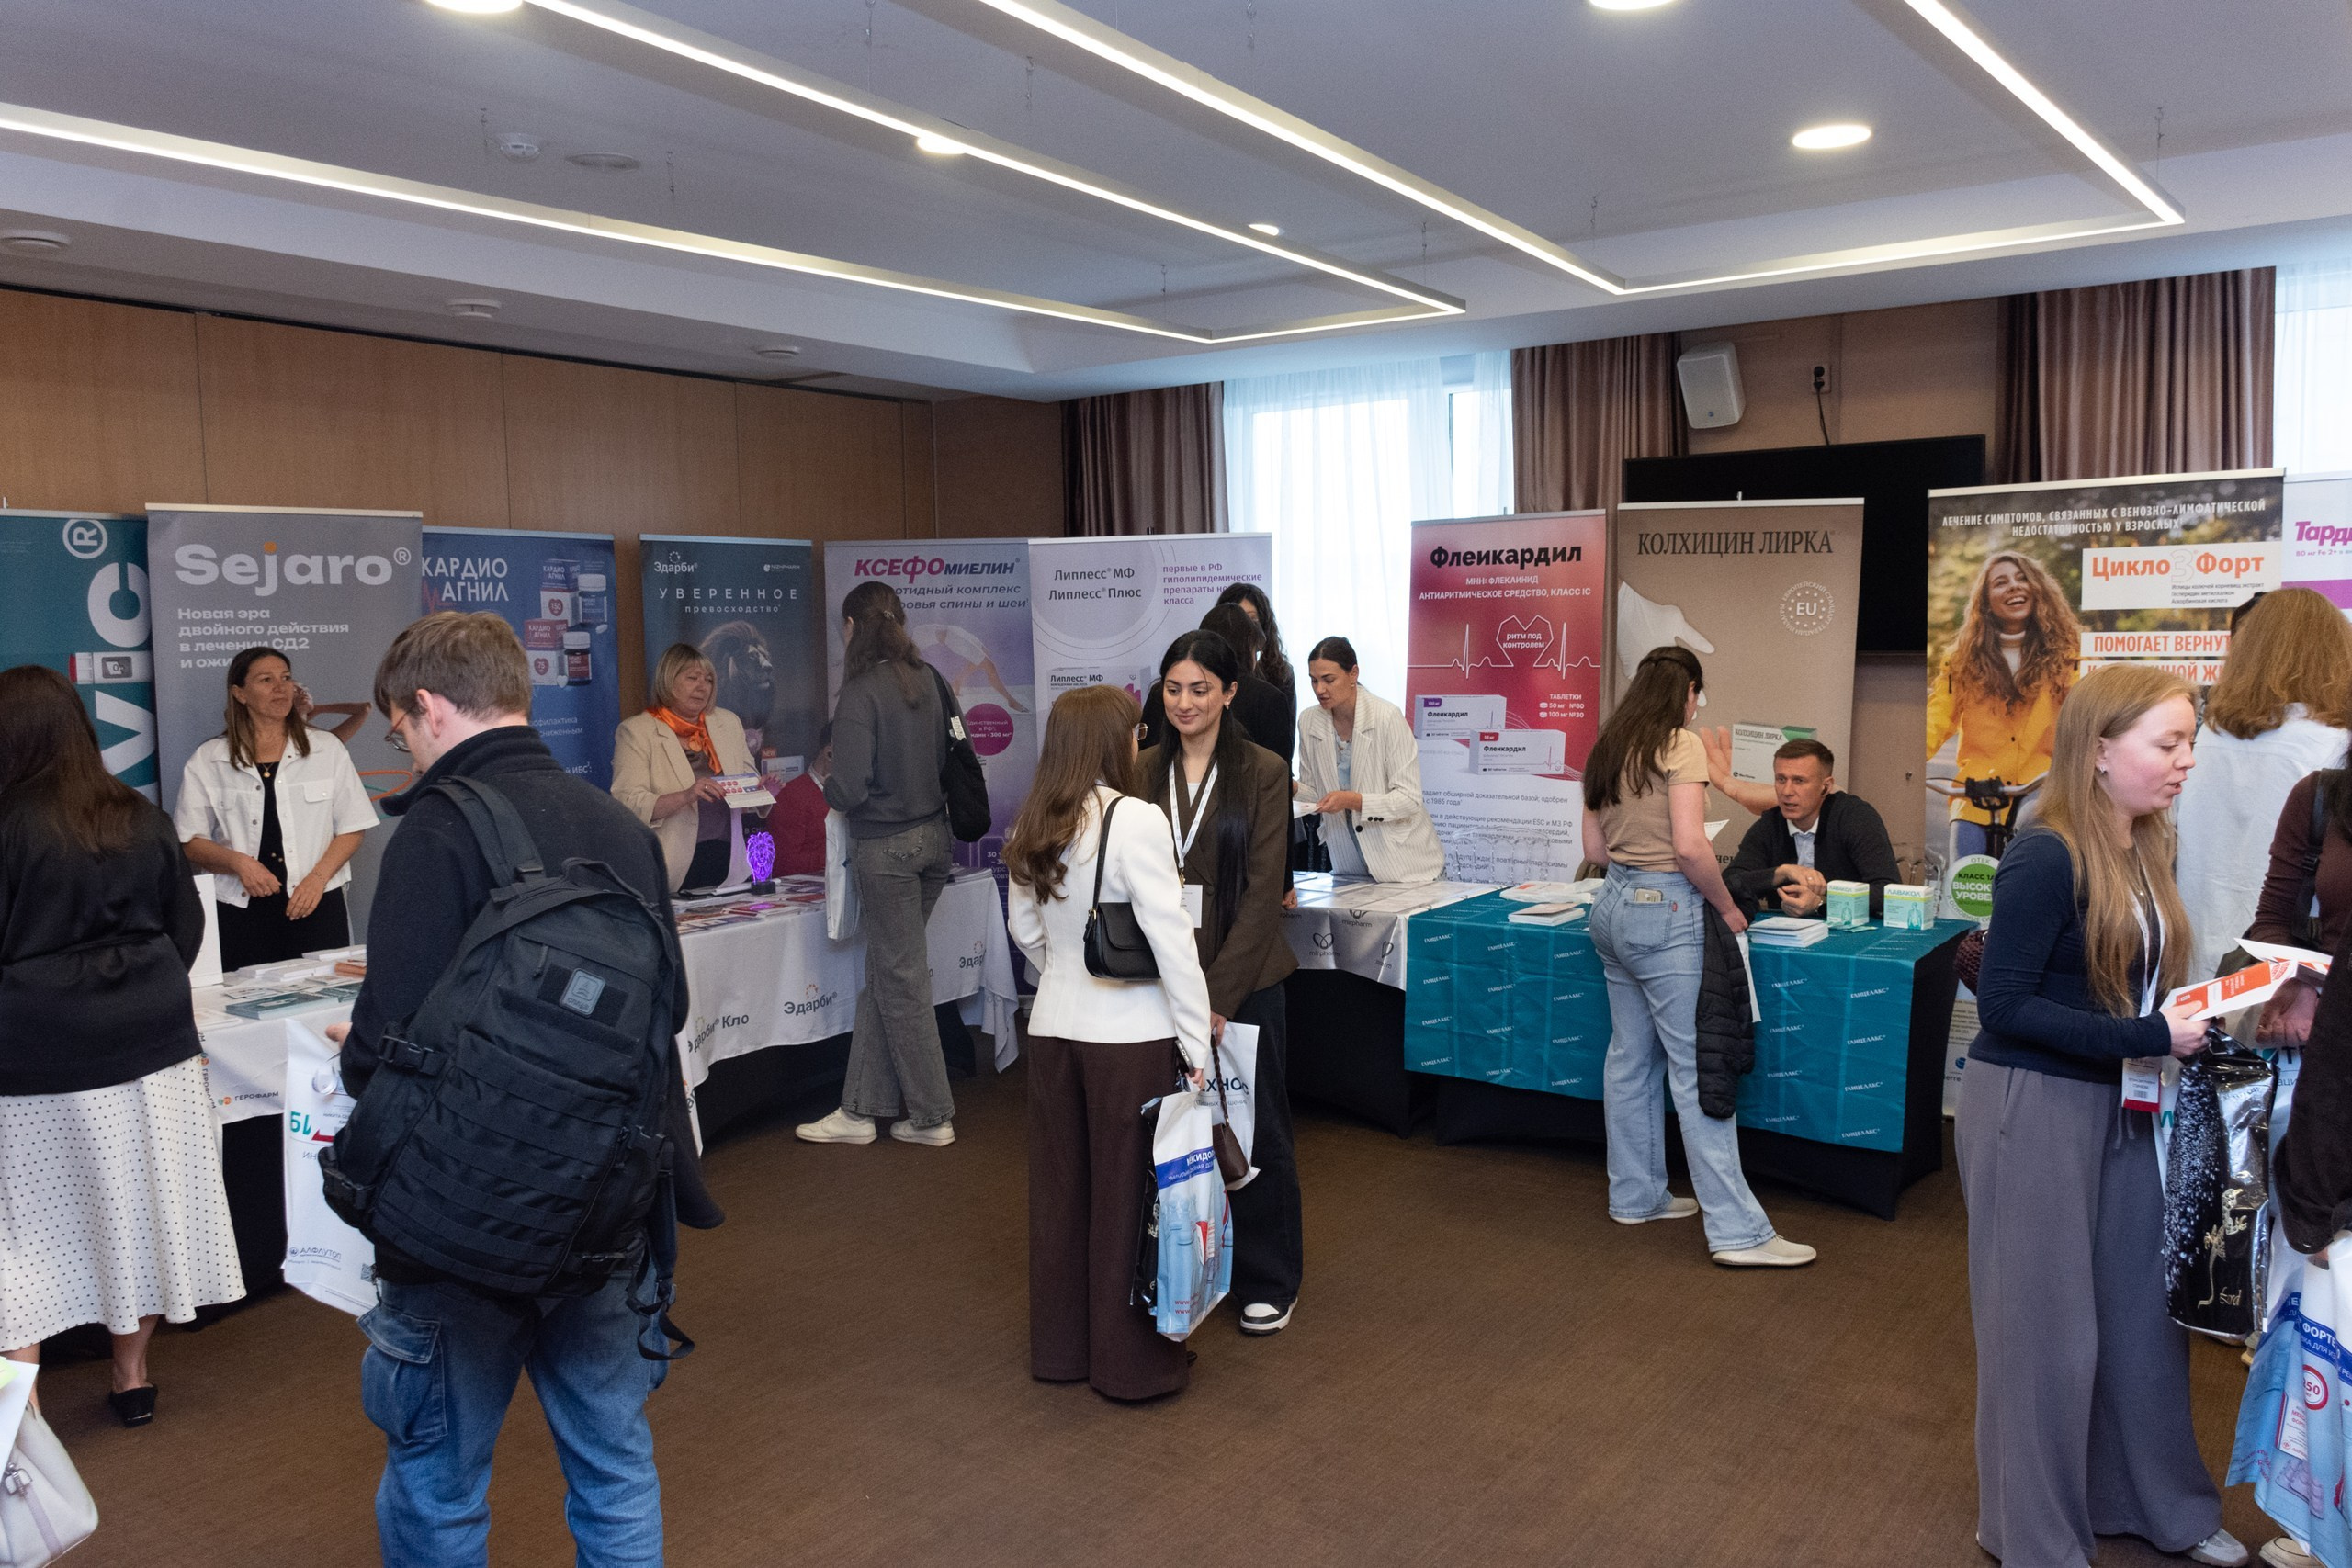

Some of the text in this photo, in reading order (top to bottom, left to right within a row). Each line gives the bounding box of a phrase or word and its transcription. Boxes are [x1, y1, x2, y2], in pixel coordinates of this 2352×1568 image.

[1942, 498, 2266, 527] ЛЕЧЕНИЕ СИМПТОМОВ, СВЯЗАННЫХ С ВЕНОЗНО-ЛИМФАТИЧЕСКОЙ
[2012, 522, 2112, 537] НЕДОСТАТОЧНОСТЬЮ
[2115, 520, 2122, 532] У
[2295, 521, 2352, 547] Тард
[1637, 531, 1755, 558] КОЛХИЦИН
[422, 557, 508, 580] КАРДИО
[1163, 565, 1198, 573] первые
[1208, 563, 1223, 572] РФ
[2092, 556, 2171, 581] Цикло
[2196, 552, 2265, 579] Форт
[1113, 567, 1135, 579] МФ
[1163, 573, 1262, 584] гиполипидемические
[1466, 575, 1538, 585] МНН: ФЛЕКАИНИД
[442, 581, 510, 603] АГНИЛ
[659, 588, 797, 600] УВЕРЕННОЕ
[897, 584, 1021, 595] отидный комплекс
[1108, 587, 1142, 598] Плюс
[1163, 585, 1215, 595] препараты
[1419, 590, 1502, 600] АНТИАРИТМИЧЕСКОЕ
[1504, 589, 1549, 598] СРЕДСТВО,
[1551, 588, 1581, 596] КЛАСС
[940, 599, 983, 609] спины
[986, 600, 994, 608] и
[1163, 597, 1194, 605] класса
[177, 607, 270, 621] Новая эра
[1796, 602, 1817, 615] EU
[178, 622, 349, 637] двойного действия
[1507, 632, 1542, 641] ритм под
[179, 637, 310, 652] в лечении СД2
[1503, 641, 1544, 649] контролем
[2094, 634, 2231, 653] ПОМОГАЕТ ВЕРНУТ
[181, 658, 233, 669] и ожи
[530, 716, 578, 727] офилактика
[1443, 791, 1475, 799] обширной
[1475, 793, 1520, 801] доказательной
[1542, 796, 1568, 805] одобрен
[1444, 814, 1486, 823] действующие
[1487, 817, 1532, 825] рекомендации
[1886, 888, 1921, 897] ЛАВАКОЛ
[1952, 882, 1992, 892] ВЫСОК
[1956, 891, 1992, 901] УРОВЕ
[1342, 919, 1373, 928] mirpharm
[722, 1014, 750, 1029] Кло
[235, 1090, 279, 1101] ГЕРОФАРМ
[2302, 1323, 2335, 1348] ФОРТЕ
